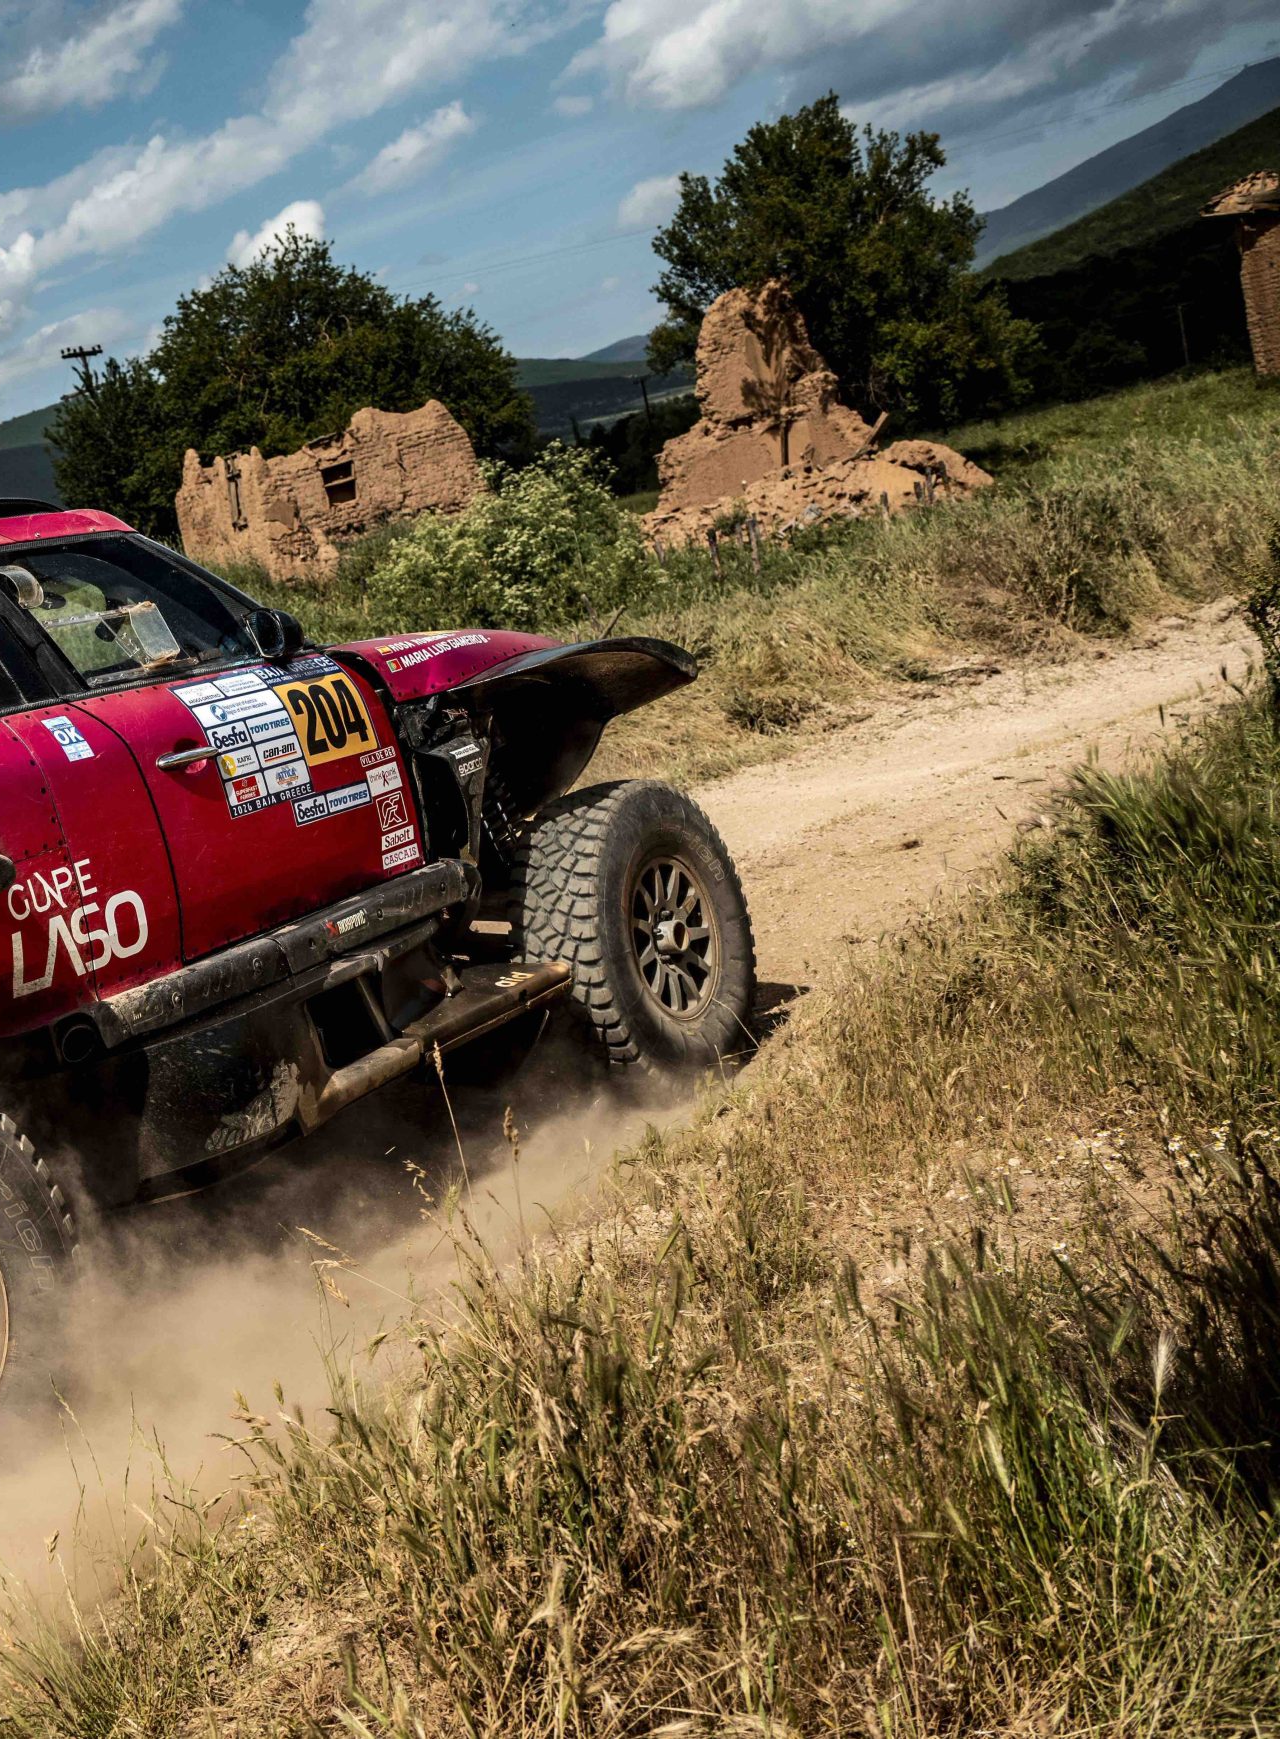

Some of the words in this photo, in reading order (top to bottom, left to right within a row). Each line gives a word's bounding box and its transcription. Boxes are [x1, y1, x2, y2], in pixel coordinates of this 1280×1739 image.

[400, 649, 433, 667] MARIA
[428, 641, 452, 656] LUIS
[287, 656, 334, 673] GREECE
[250, 722, 269, 734] TOYO
[270, 717, 290, 729] TIRES
[287, 679, 369, 756] 204
[53, 726, 85, 745] OK
[263, 742, 296, 759] can-am
[376, 752, 384, 760] DE
[459, 757, 483, 775] sparco
[233, 804, 253, 816] 2026
[256, 795, 277, 809] BAJA
[280, 783, 312, 800] GREECE
[329, 796, 348, 808] TOYO
[349, 789, 368, 802] TIRES
[384, 828, 411, 848] Sabelt
[383, 846, 418, 866] CASCAIS
[11, 890, 149, 999] LASO
